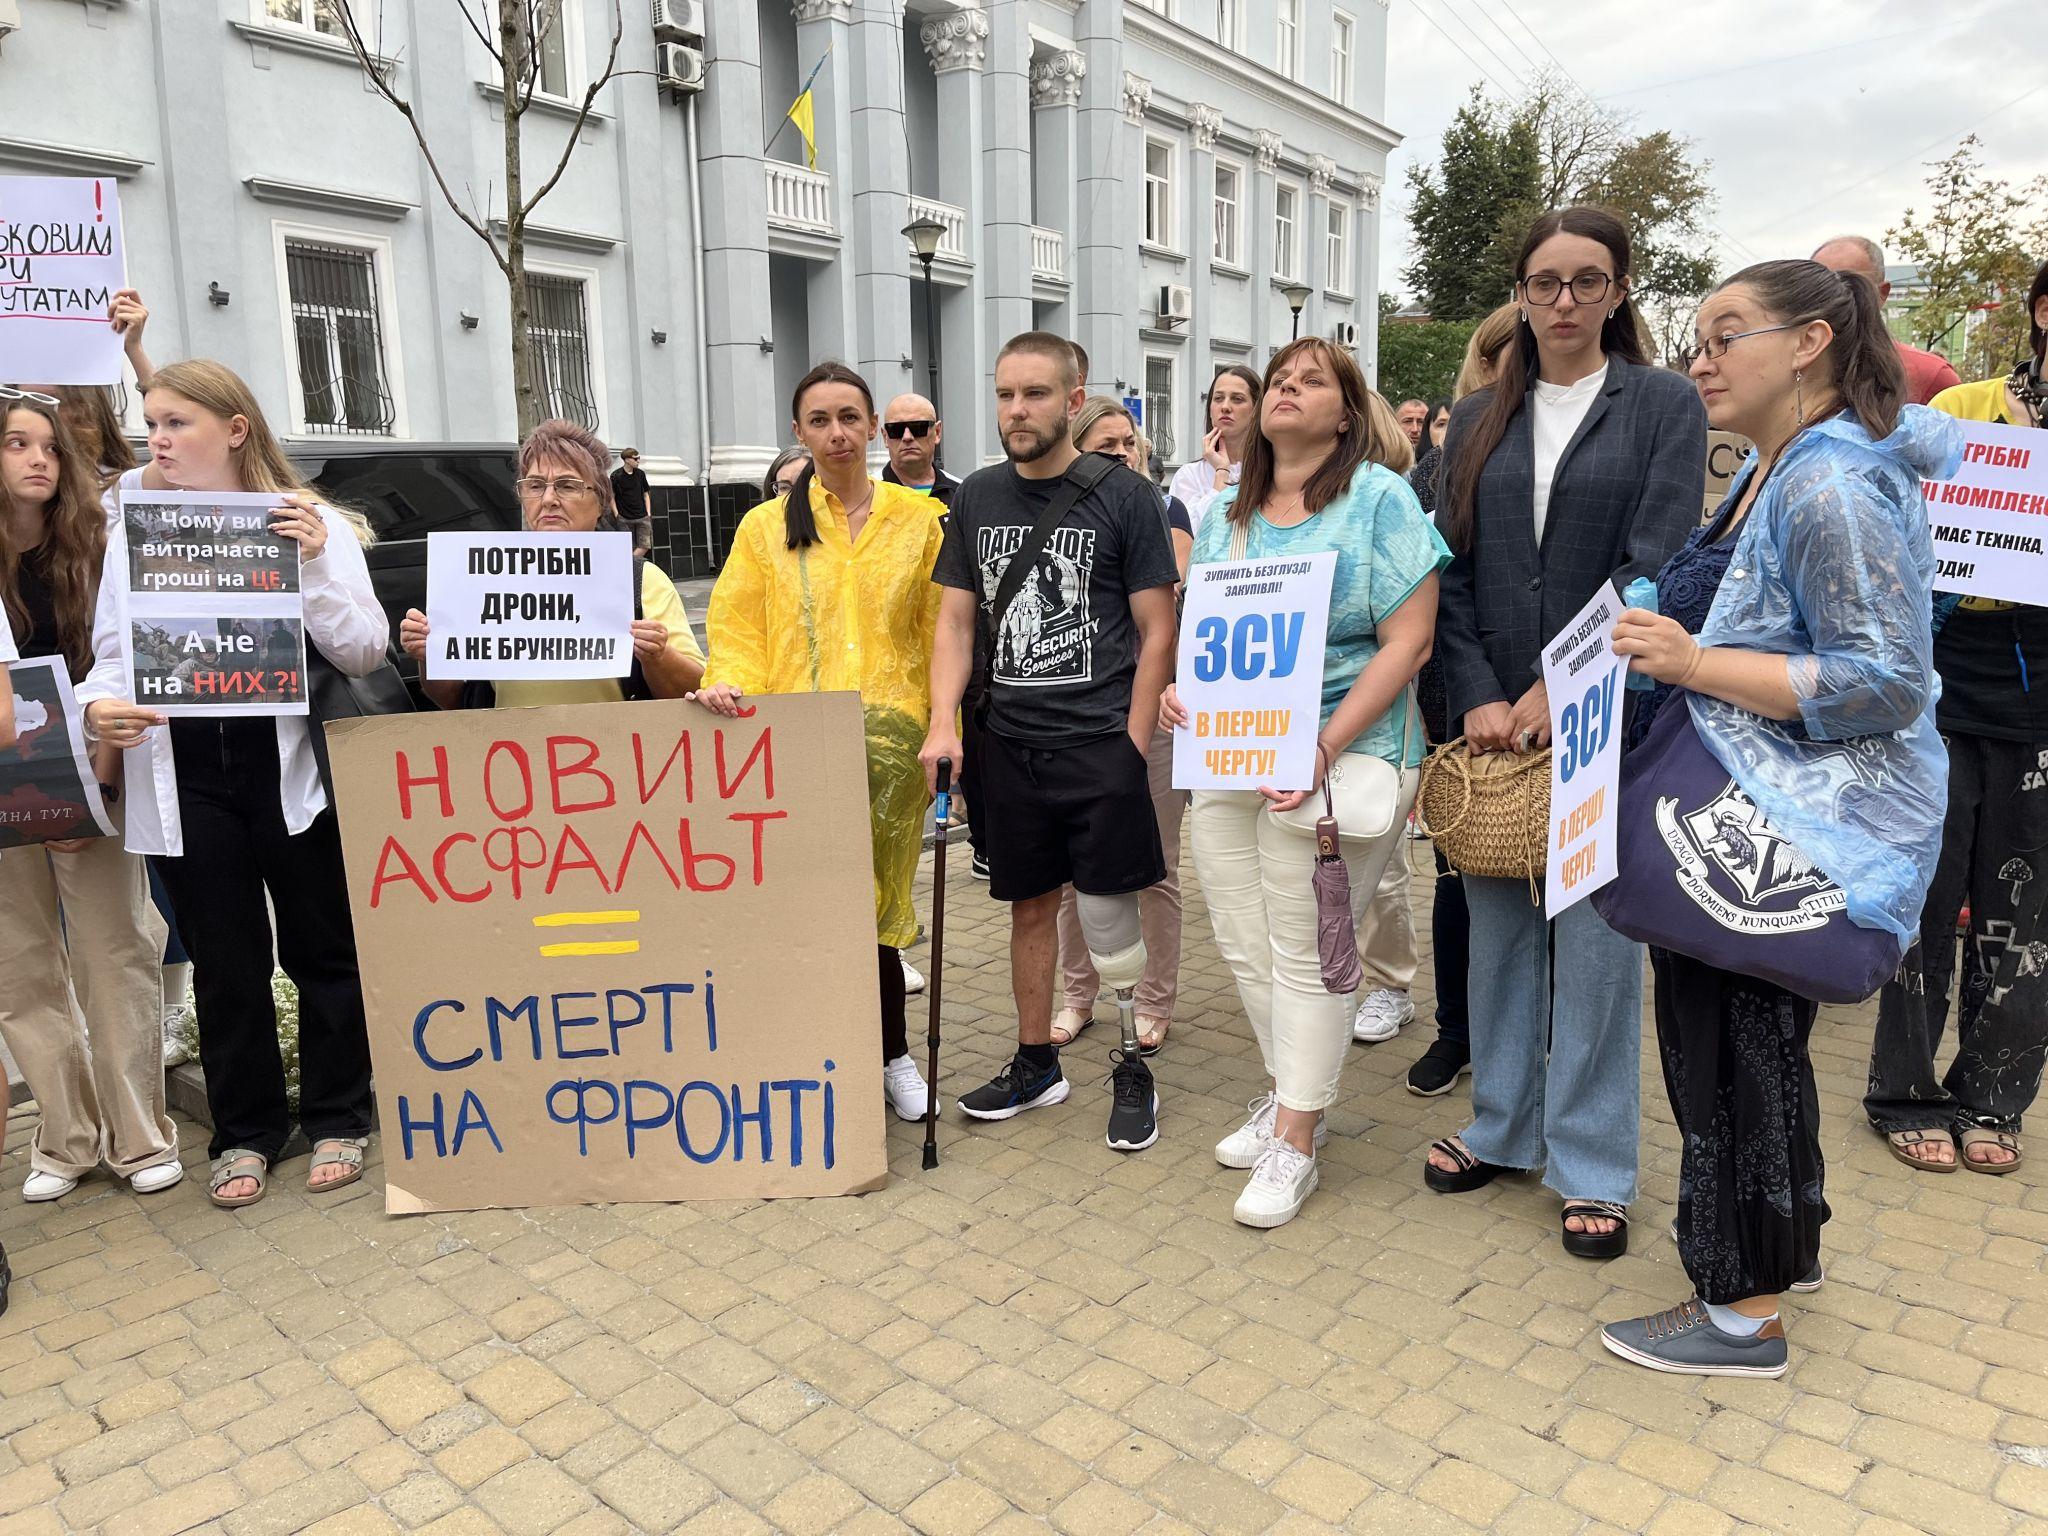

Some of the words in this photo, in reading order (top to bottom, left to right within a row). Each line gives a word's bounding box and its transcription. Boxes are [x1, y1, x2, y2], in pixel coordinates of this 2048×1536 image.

[0, 286, 109, 312] УТАТАМ
[1963, 442, 2031, 469] ТРІБНІ
[161, 511, 225, 534] Чому
[232, 516, 262, 530] ви
[142, 543, 280, 562] витрачаєте
[978, 526, 1033, 569] DAR
[1934, 525, 1972, 544] МАЄ
[1975, 530, 2044, 556] ТЕХНІКА,
[468, 547, 592, 576] ПОТРІБНІ
[1204, 567, 1252, 582] ЗУПИНІТЬ
[1254, 561, 1312, 578] БЕЗГЛУЗДІ
[143, 569, 210, 590] гроші
[217, 572, 245, 587] на
[251, 569, 287, 591] ЦЕ,
[1224, 581, 1283, 597] ЗАКУПІВЛІ!
[480, 592, 581, 624] ДРОНИ,
[183, 630, 206, 653] А
[216, 633, 254, 653] не
[446, 637, 460, 660] А
[465, 637, 492, 660] НЕ
[498, 637, 616, 661] БРУКІВКА!
[1032, 618, 1100, 658] SECURITY
[1194, 611, 1306, 682] ЗСУ
[1550, 633, 1580, 667] ЗУПИНІТЬ
[1577, 602, 1611, 643] БЕЗГЛУЗДІ
[1022, 649, 1076, 677] Services
[1568, 636, 1605, 677] ЗАКУПІВЛІ!
[142, 676, 182, 695] на
[193, 670, 267, 694] НИХ
[273, 669, 298, 694] ?!
[1195, 711, 1210, 738] В
[1215, 709, 1292, 737] ПЕРШУ
[1560, 664, 1618, 784] ЗСУ
[395, 705, 775, 822] НОВИЙ
[1205, 749, 1277, 776] ЧЕРГУ!
[2021, 771, 2048, 791] SA
[1558, 818, 1566, 851] В
[1568, 785, 1605, 844] ПЕРШУ
[370, 810, 788, 908] АСФАЛЬТ
[1667, 829, 1695, 865] DRACO
[1562, 839, 1596, 891] ЧЕРГУ!
[1686, 876, 1737, 923] DORMIENS
[1740, 913, 1811, 928] NUNQUAM
[412, 969, 719, 1072] СМЕРТІ
[397, 1088, 505, 1161] НА
[545, 1059, 837, 1171] ФРОНТІ
